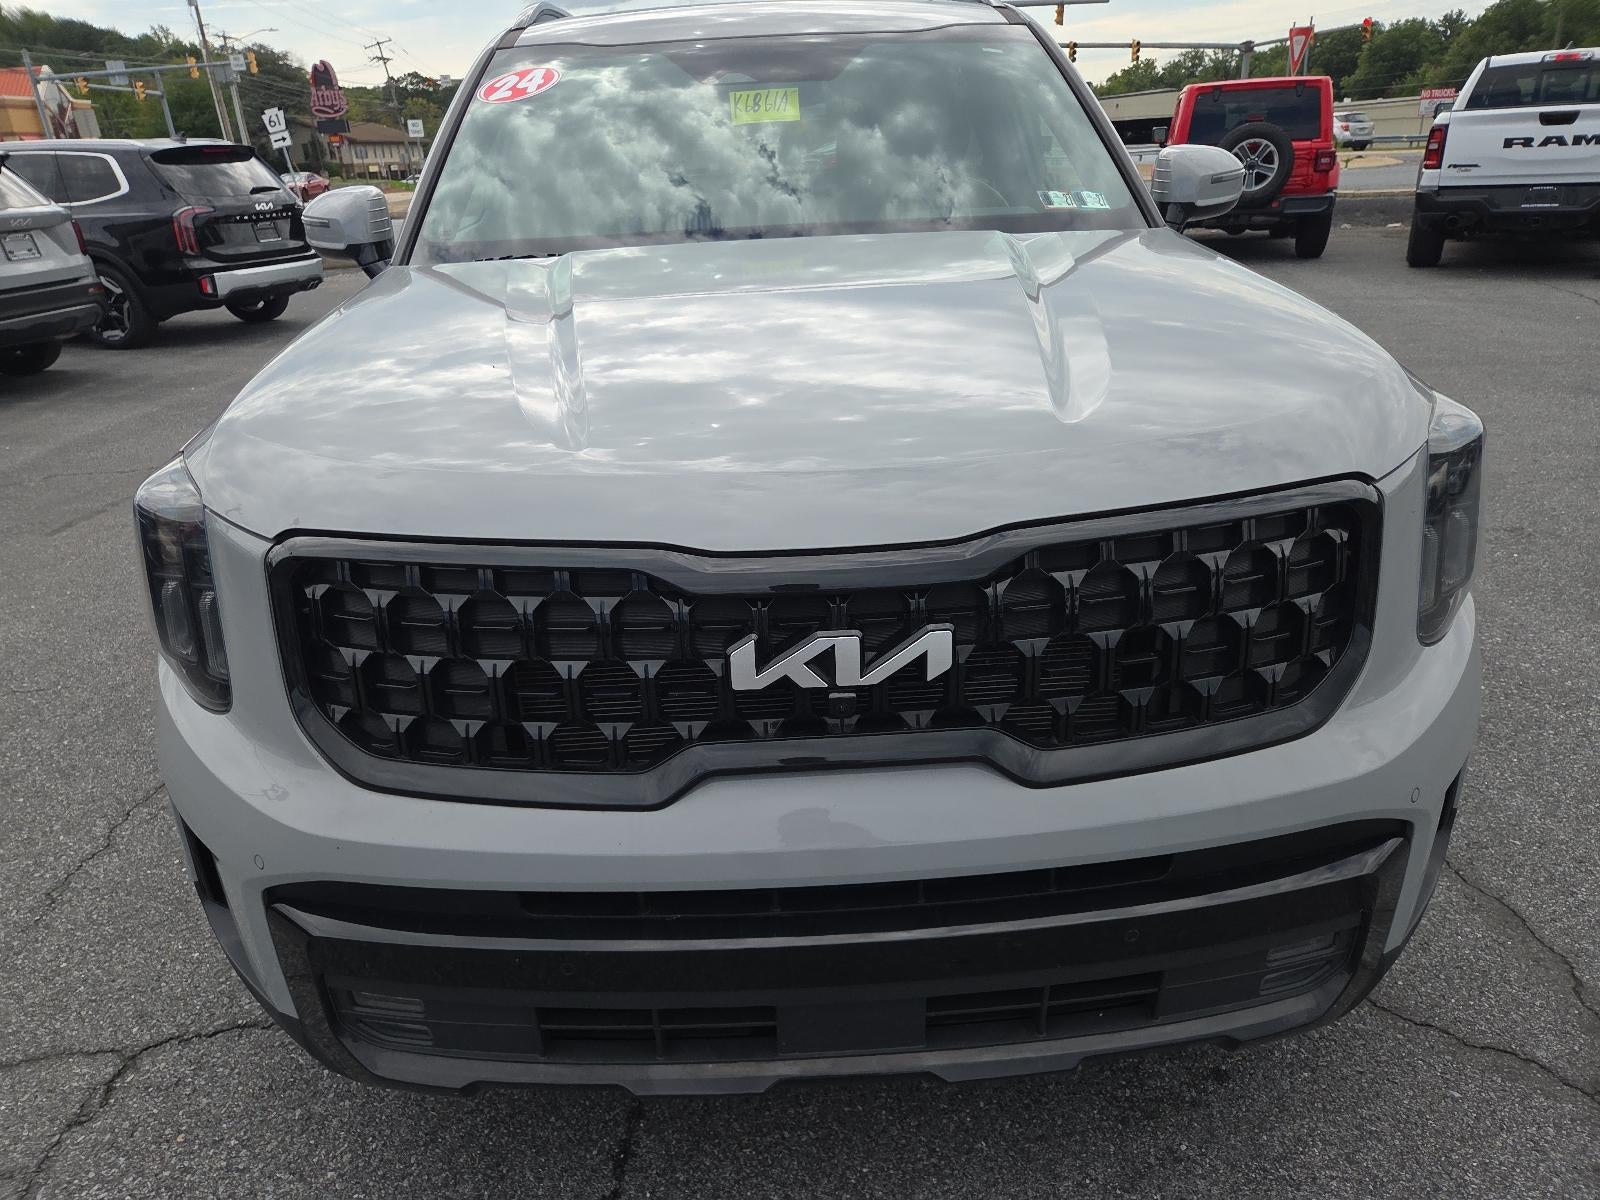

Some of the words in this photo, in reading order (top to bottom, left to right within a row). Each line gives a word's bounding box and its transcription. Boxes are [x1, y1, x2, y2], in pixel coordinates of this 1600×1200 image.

[488, 70, 546, 101] 24
[1421, 89, 1431, 98] NO
[1432, 87, 1456, 97] TRUCKS
[311, 84, 346, 110] Arby's
[269, 114, 282, 128] 61
[1503, 134, 1600, 148] RAM
[726, 623, 954, 691] KIA
